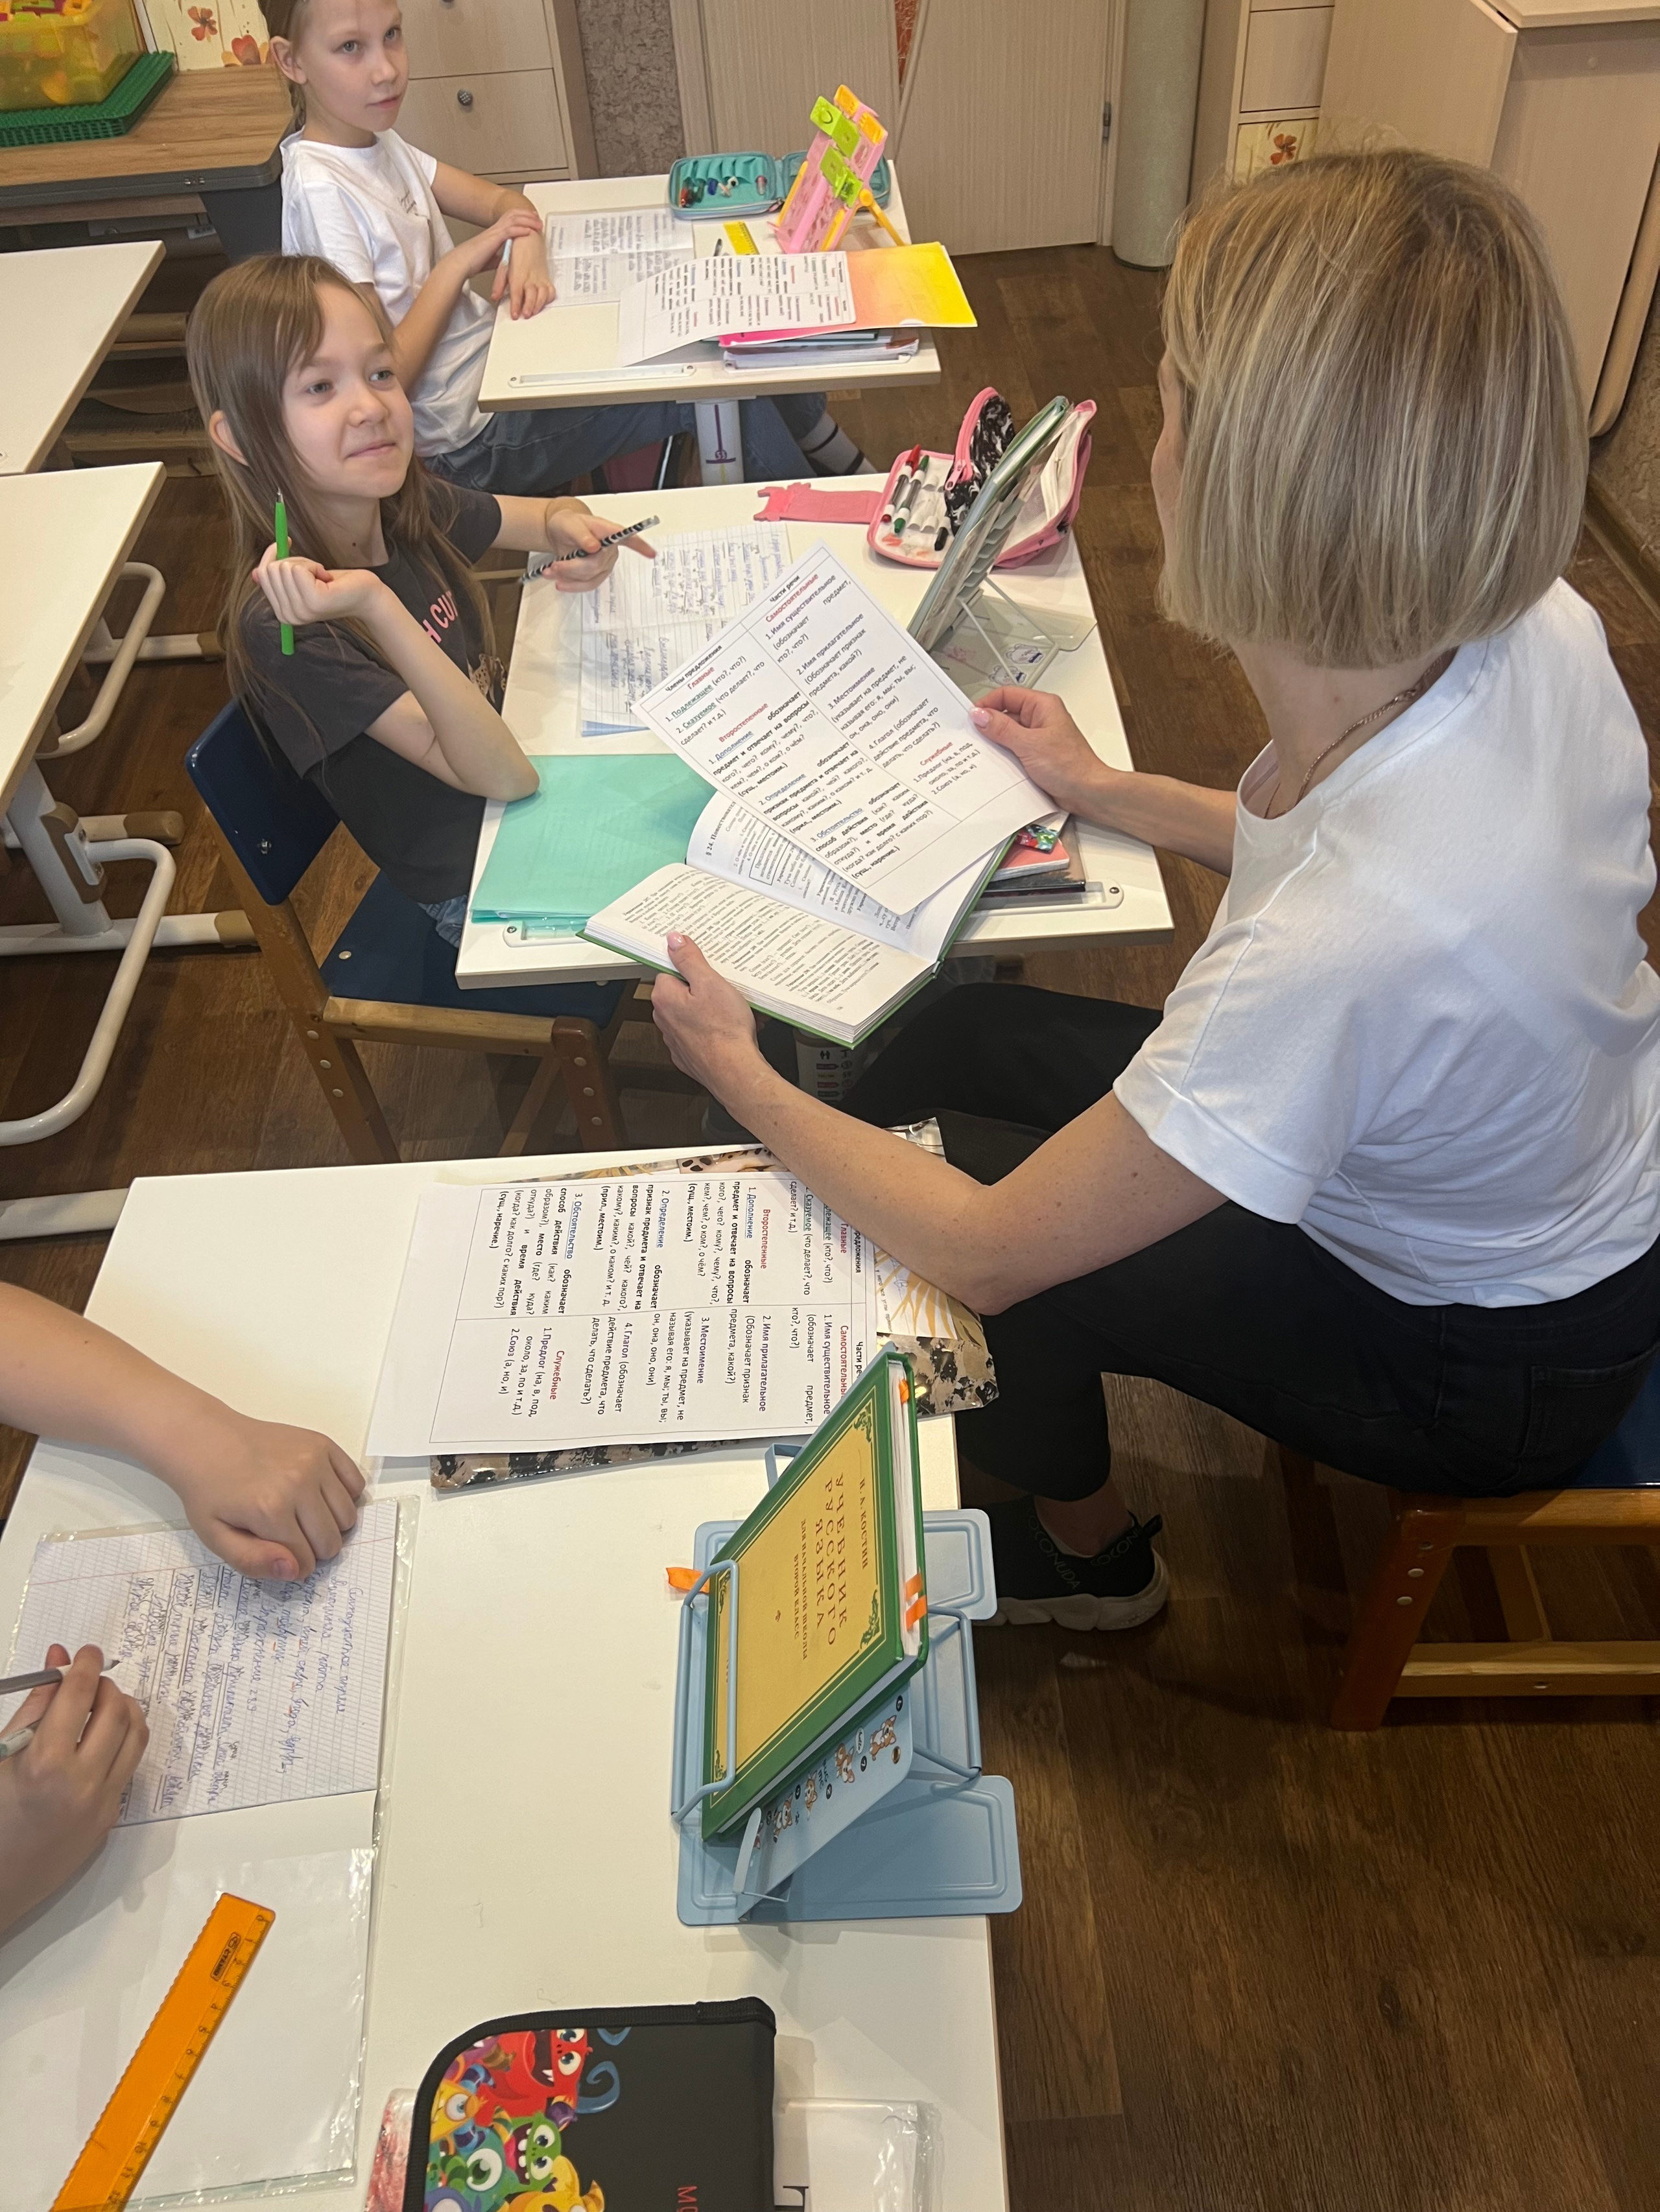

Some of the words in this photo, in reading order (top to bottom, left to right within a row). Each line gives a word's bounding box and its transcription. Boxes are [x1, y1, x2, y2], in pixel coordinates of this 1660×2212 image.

[496, 1191, 510, 1212] (сущ.,
[525, 1189, 537, 1219] откуда?)
[538, 1188, 554, 1228] образом?),
[558, 1188, 567, 1213] способ
[629, 1184, 639, 1217] вопросы
[645, 1184, 654, 1215] признак
[687, 1183, 698, 1205] (сущ.,
[717, 1182, 726, 1203] кого?,
[731, 1181, 741, 1212] предмет
[657, 1197, 670, 1248] Определение
[683, 1205, 694, 1242] местоим.)
[717, 1206, 725, 1226] чего?
[746, 1194, 757, 1238] Дополнение
[804, 1194, 814, 1231] Сказуемое
[488, 1213, 503, 1249] наречие.)
[536, 1233, 545, 1256] место
[551, 1219, 563, 1255] действия
[566, 1201, 582, 1259] Обстоятельство
[624, 1222, 635, 1250] какой?,
[641, 1217, 651, 1254] предмета
[713, 1229, 723, 1254] кому?,
[729, 1222, 738, 1255] отвечает
[760, 1209, 771, 1269] Второстепенные
[803, 1234, 813, 1248] (что
[840, 1223, 849, 1254] Главные
[517, 1244, 528, 1269] время
[623, 1255, 632, 1273] чей?
[729, 1258, 736, 1267] на
[802, 1249, 812, 1280] делает?,
[823, 1243, 833, 1263] (кто?,
[531, 1262, 543, 1281] (где?
[547, 1263, 558, 1282] (как?
[635, 1264, 646, 1298] отвечает
[711, 1256, 721, 1282] чему?,
[742, 1260, 753, 1304] обозначает
[822, 1264, 833, 1283] что?)
[510, 1279, 523, 1315] действия
[558, 1269, 572, 1314] обозначает
[617, 1279, 628, 1311] какого?,
[650, 1264, 663, 1309] обозначает
[709, 1285, 720, 1305] что?,
[726, 1270, 735, 1304] вопросы
[525, 1293, 536, 1315] куда?
[541, 1290, 552, 1315] каким
[634, 1300, 642, 1310] на
[790, 1307, 801, 1326] кто?,
[588, 1317, 600, 1347] делать,
[605, 1316, 617, 1354] действие
[621, 1330, 633, 1358] Глагол
[683, 1311, 695, 1355] (указывает
[727, 1308, 737, 1350] предмета,
[744, 1315, 756, 1367] (Обозначает
[789, 1328, 800, 1348] что?)
[806, 1314, 817, 1363] (обозначает
[824, 1322, 833, 1339] Имя
[503, 1359, 516, 1369] (а,
[587, 1348, 596, 1363] что
[682, 1357, 689, 1367] на
[840, 1325, 849, 1397] Самостоятельны
[855, 1341, 864, 1363] Части
[501, 1371, 510, 1384] но,
[533, 1371, 546, 1387] (на,
[549, 1350, 565, 1400] Служебные
[598, 1355, 611, 1399] предмета,
[724, 1352, 736, 1384] какой?)
[822, 1341, 831, 1415] существительное
[854, 1365, 862, 1378] ре
[498, 1386, 510, 1394] и)
[580, 1364, 594, 1405] сделать?)
[615, 1361, 630, 1413] (обозначает
[676, 1369, 688, 1407] предмет,
[741, 1368, 751, 1404] признак
[528, 1399, 539, 1417] под,
[597, 1400, 606, 1415] что
[677, 1409, 684, 1420] не
[804, 1385, 813, 1424] предмет,
[835, 1473, 847, 1628] УЧЕБНИК
[860, 1512, 868, 1569] КОСТИН
[816, 1518, 824, 1629] ЯЗЫКА
[825, 1477, 836, 1645] РУССКОГО
